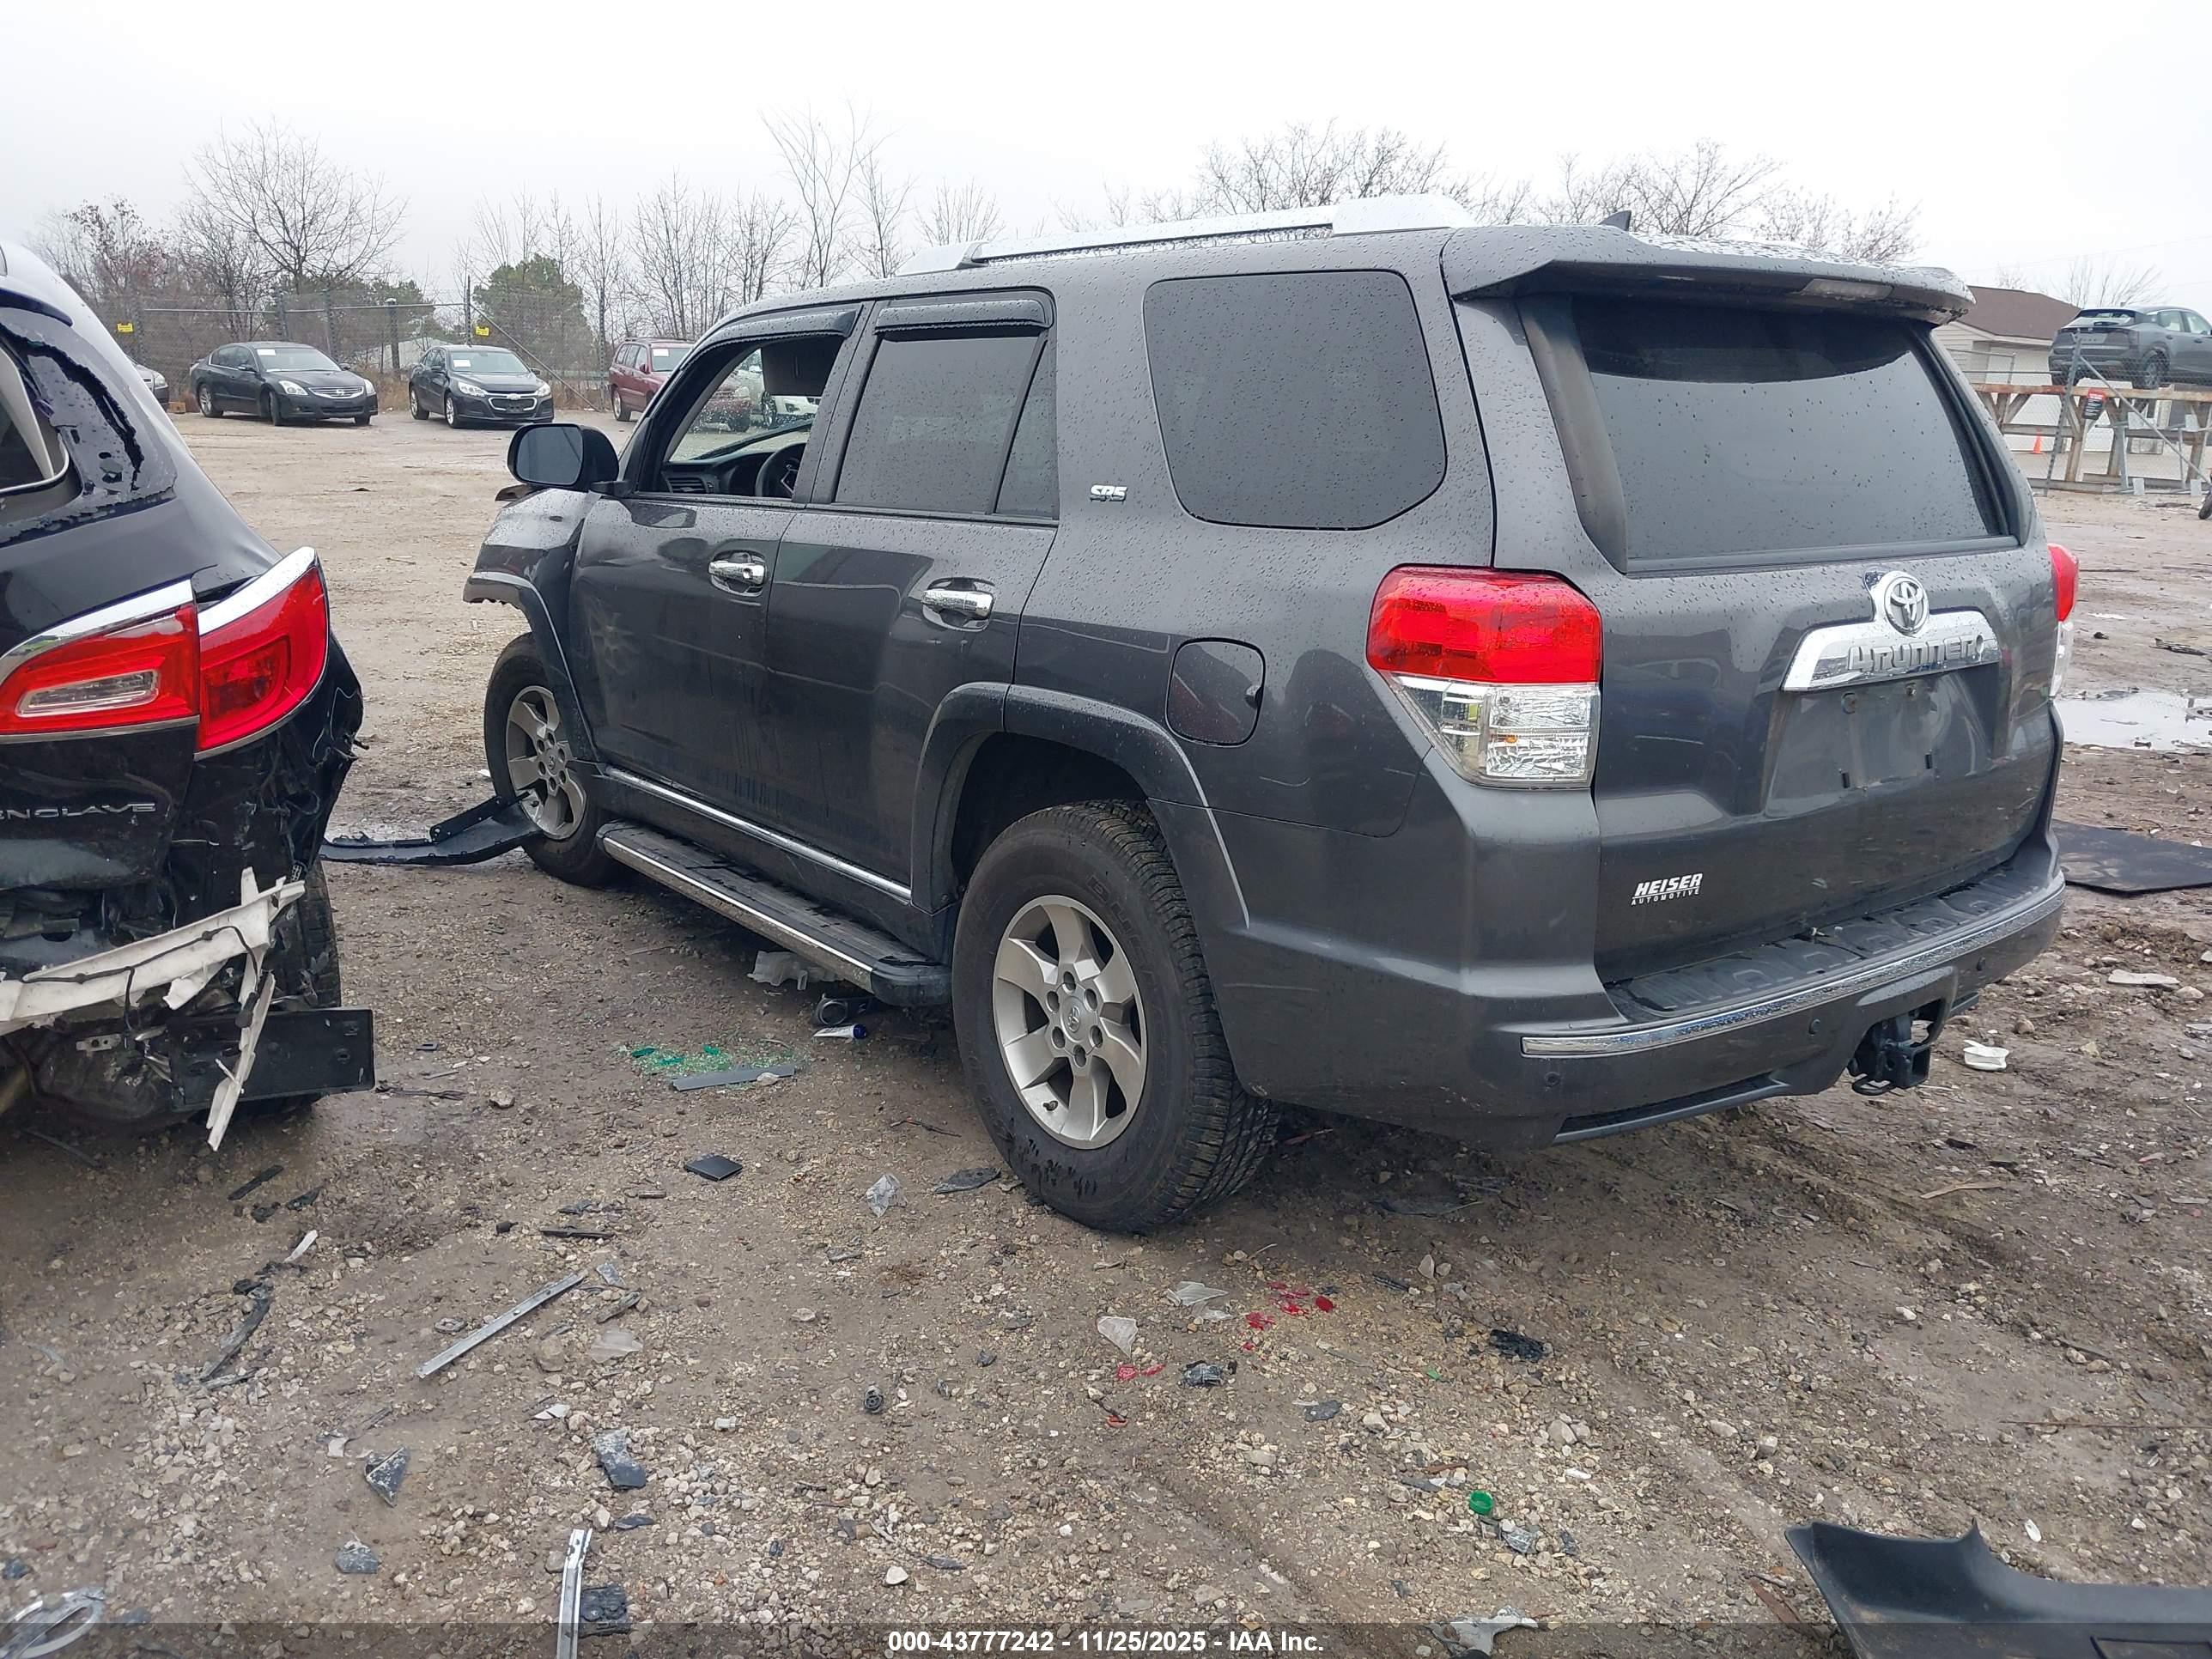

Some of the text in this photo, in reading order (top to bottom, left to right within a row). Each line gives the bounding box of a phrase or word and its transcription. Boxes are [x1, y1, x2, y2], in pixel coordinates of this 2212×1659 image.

[1091, 484, 1127, 501] SR5
[0, 803, 156, 819] NCLAVE
[1634, 872, 1703, 896] HEISER
[1631, 887, 1700, 906] AUTOMOTIVE
